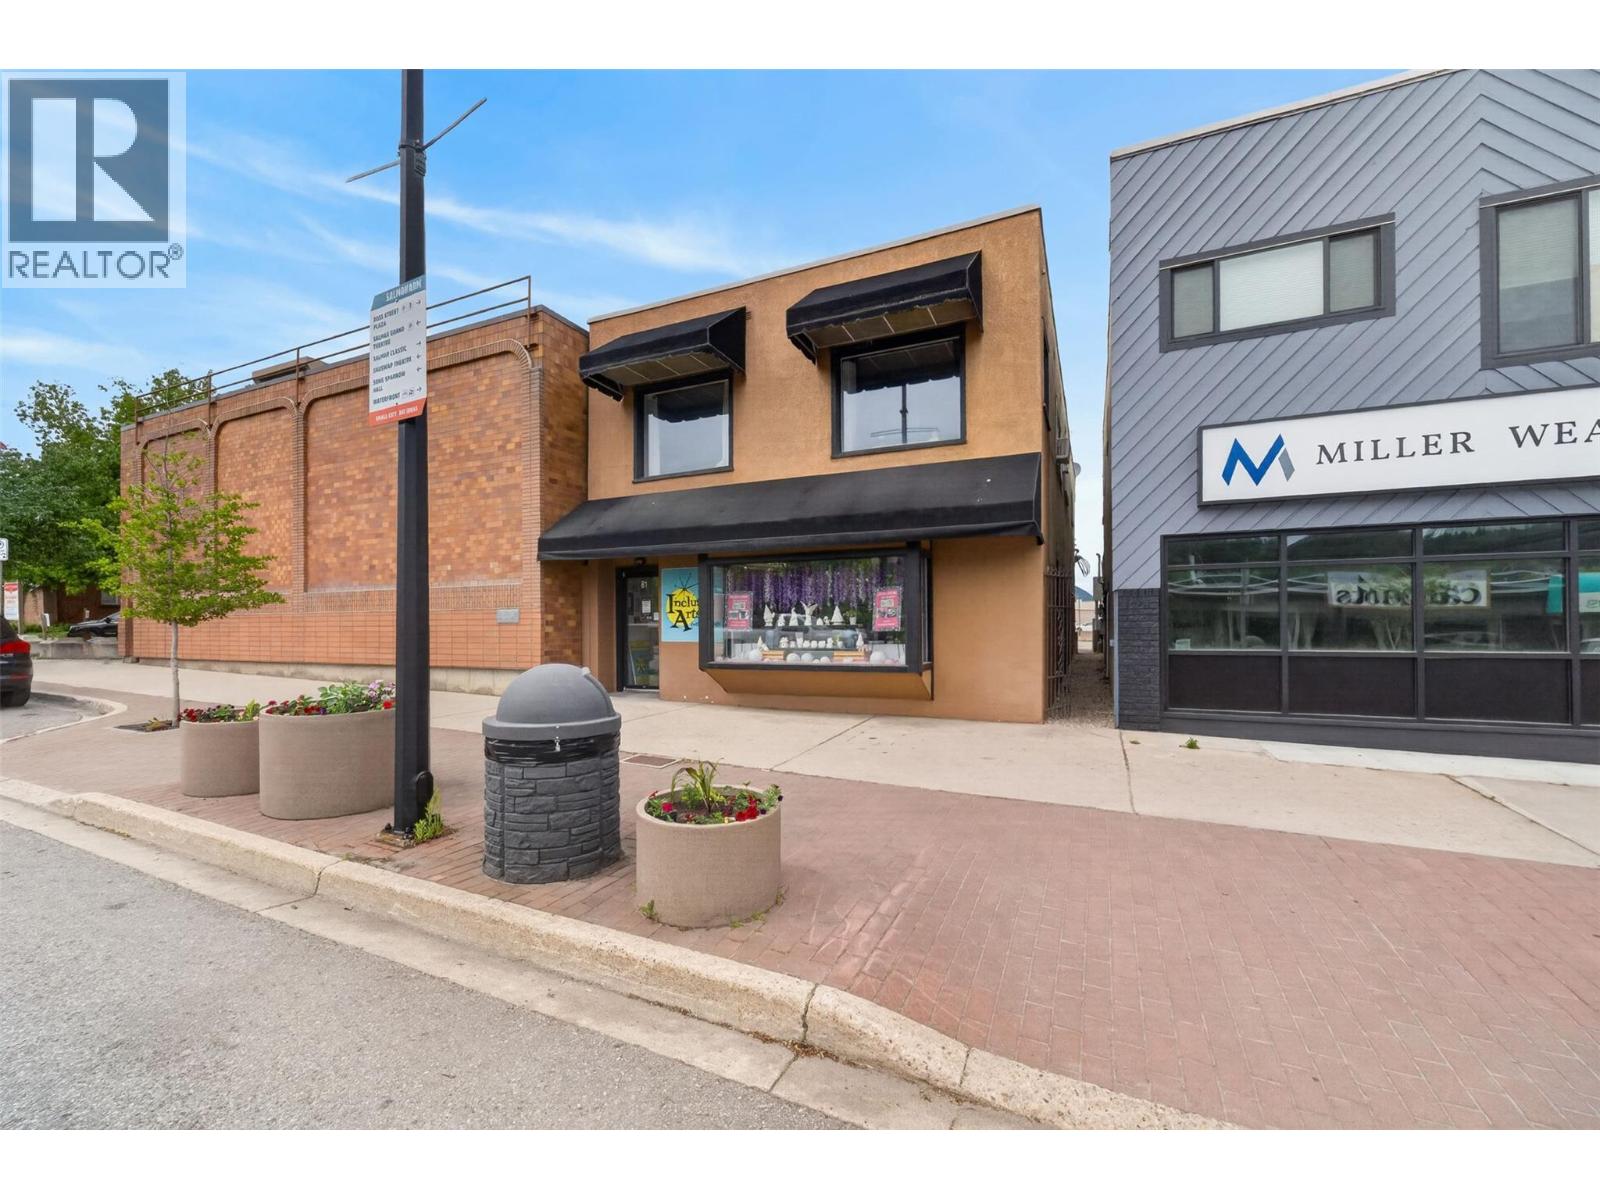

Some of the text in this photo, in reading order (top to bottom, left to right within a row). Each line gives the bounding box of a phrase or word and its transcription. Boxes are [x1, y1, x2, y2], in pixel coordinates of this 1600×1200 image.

[373, 321, 386, 330] PLAZA
[390, 345, 408, 356] CLASSIC
[373, 392, 401, 404] WATERFRONT
[1315, 431, 1475, 465] MILLER
